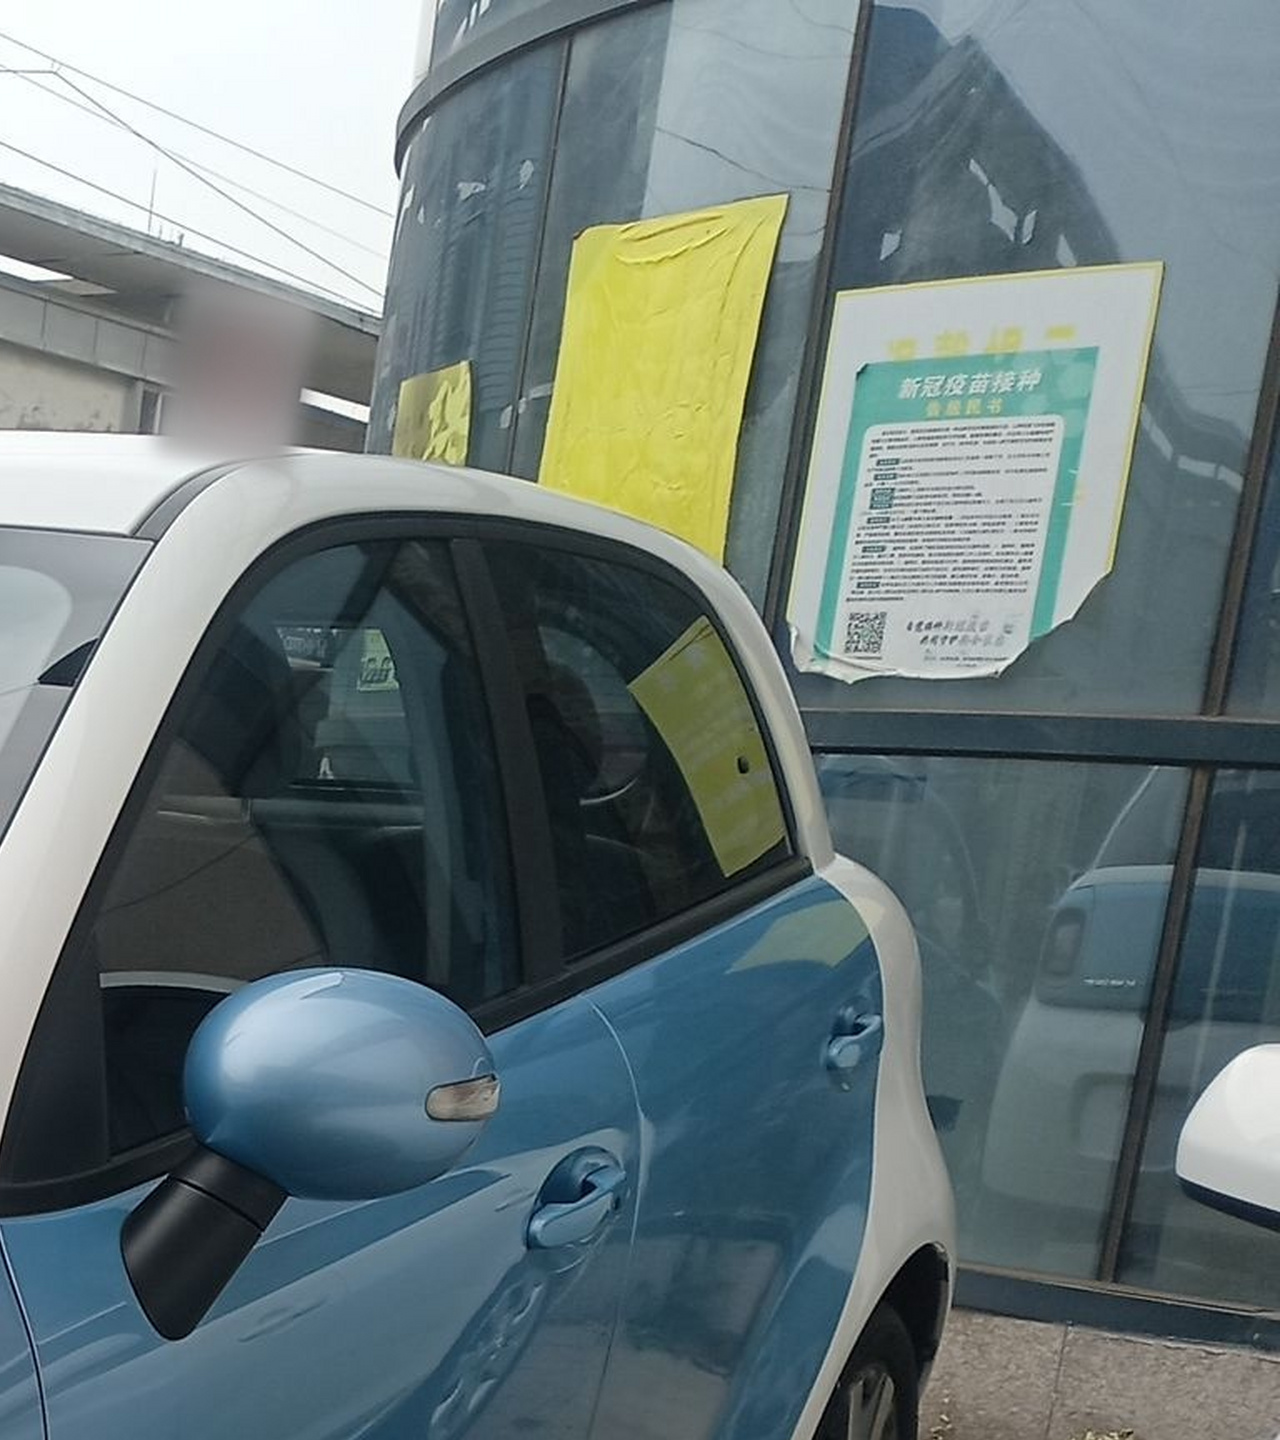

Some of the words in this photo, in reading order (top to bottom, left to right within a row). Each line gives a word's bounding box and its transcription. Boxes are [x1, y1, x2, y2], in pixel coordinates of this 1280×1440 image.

[898, 370, 1042, 400] 新冠疫苗接种
